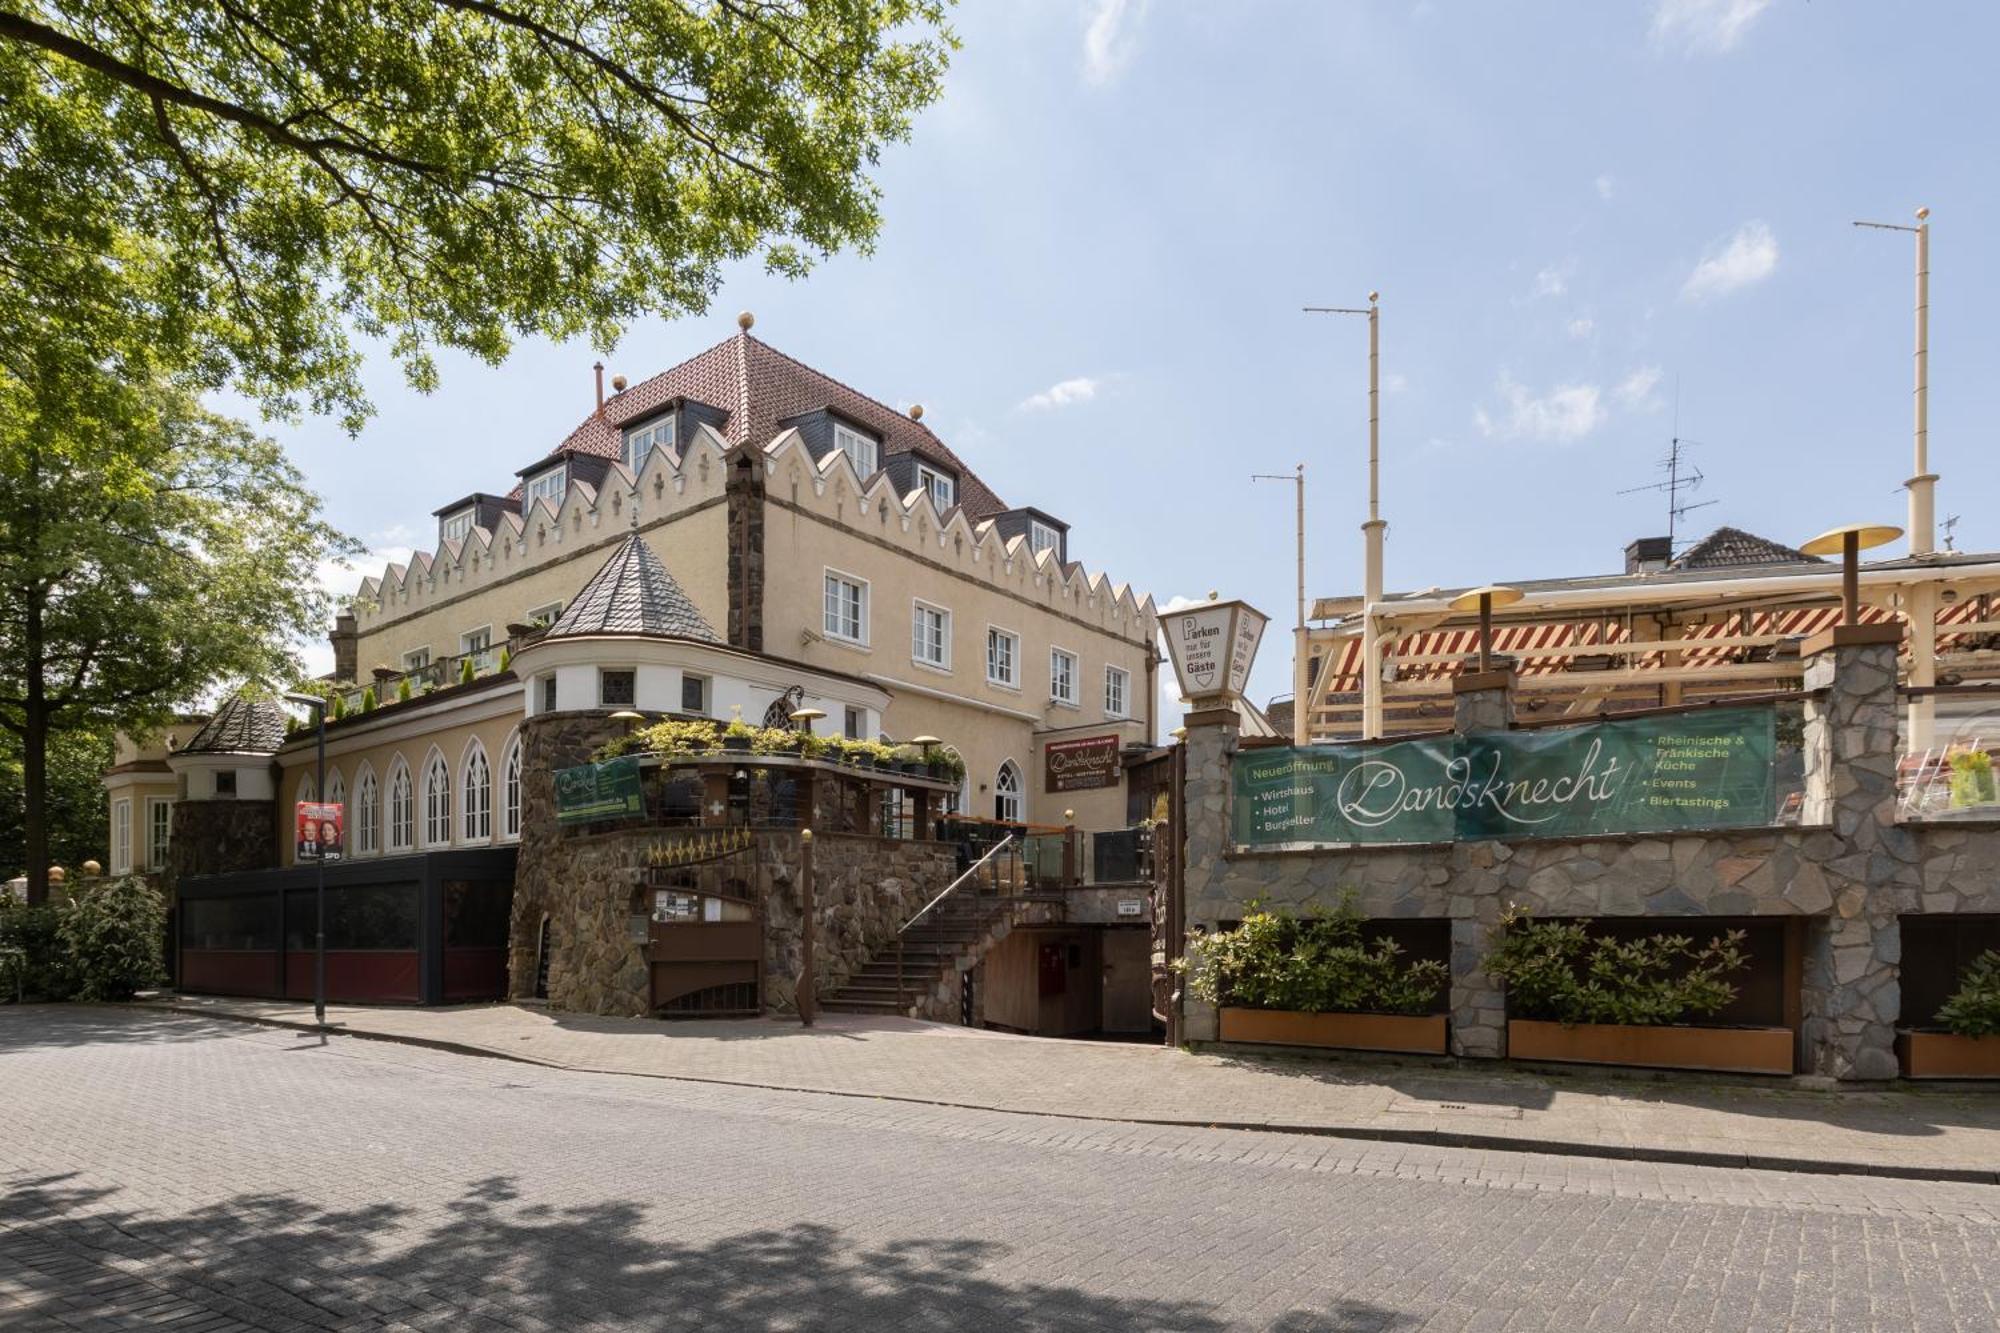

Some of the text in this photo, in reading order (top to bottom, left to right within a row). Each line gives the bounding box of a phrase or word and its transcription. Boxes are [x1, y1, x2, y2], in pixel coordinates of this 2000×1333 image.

[1182, 616, 1220, 641] Parken
[1200, 641, 1210, 649] für
[1187, 661, 1216, 674] Gäste
[1657, 735, 1745, 746] Rheinische &
[1656, 747, 1729, 758] Fränkische
[1252, 759, 1335, 779] Neueröffnung
[1655, 760, 1696, 771] Küche
[1337, 737, 1621, 827] Landsknecht
[1652, 779, 1697, 789] Events
[1261, 784, 1315, 801] Wirtshaus
[1650, 796, 1729, 809] Biertastings
[1263, 803, 1289, 816] Hotel
